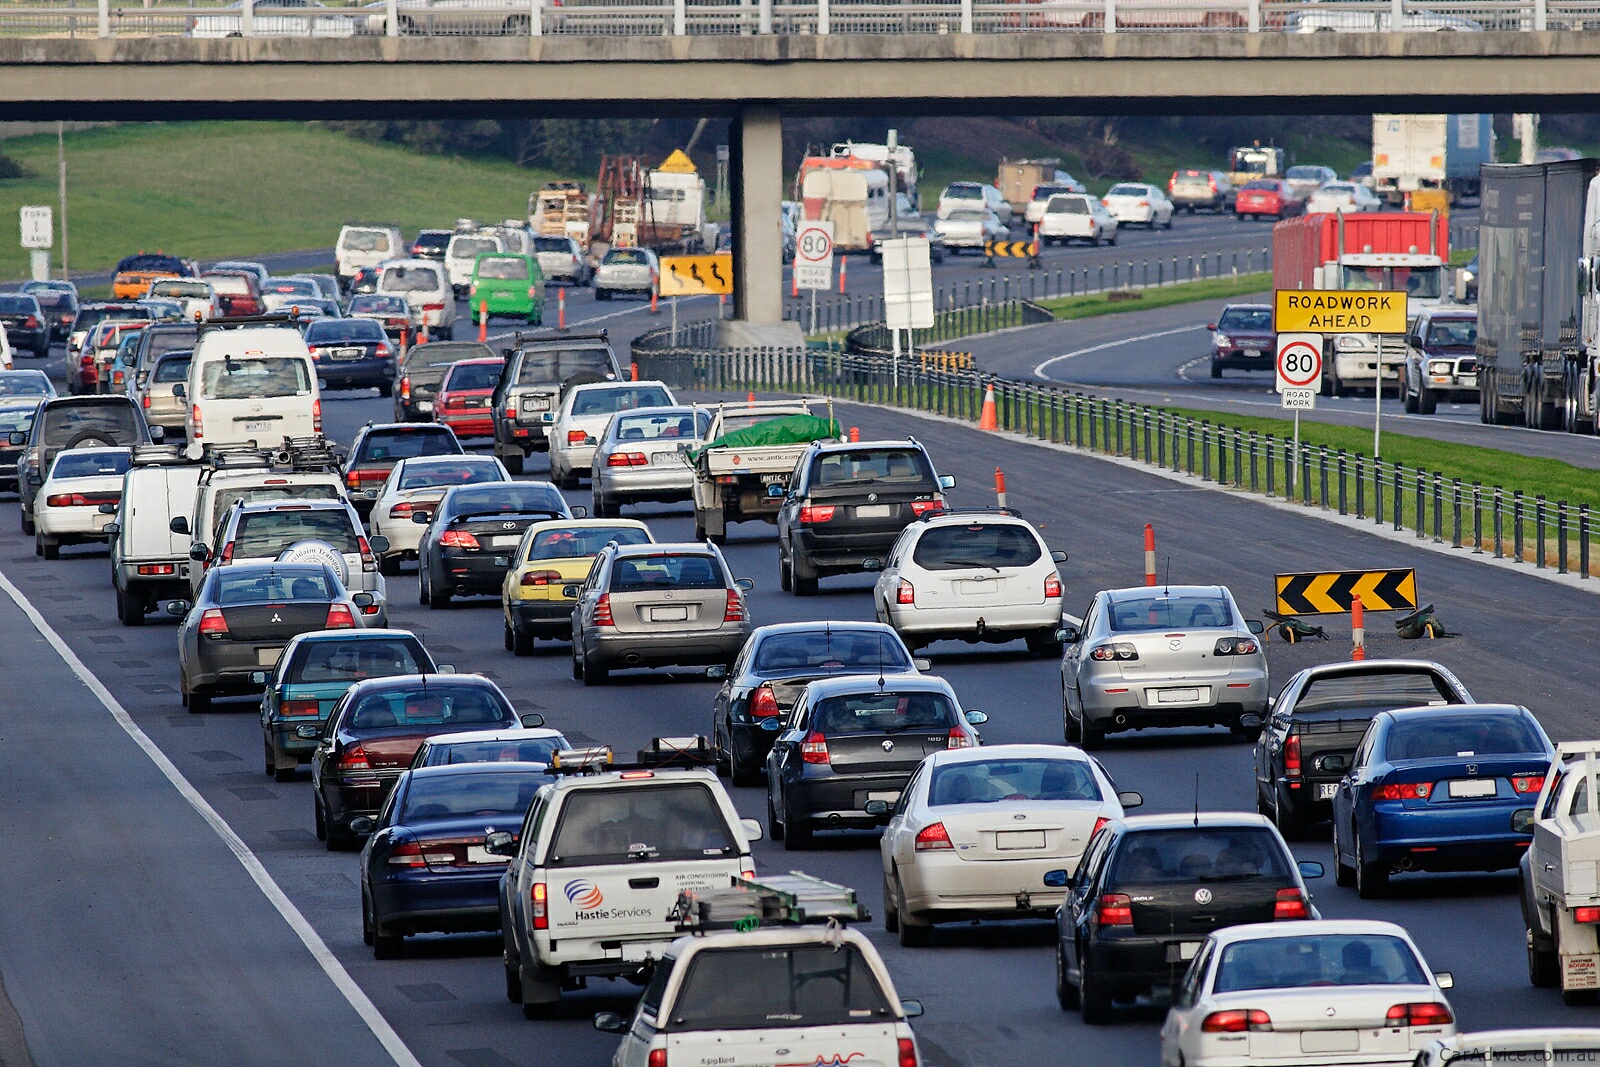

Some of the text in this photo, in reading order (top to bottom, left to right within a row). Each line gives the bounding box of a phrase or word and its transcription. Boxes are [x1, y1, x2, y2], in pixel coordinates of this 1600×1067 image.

[803, 236, 827, 253] 80
[1288, 296, 1391, 309] ROADWORK
[1309, 315, 1371, 327] AHEAD
[1286, 354, 1312, 372] 80
[374, 449, 381, 457] P
[319, 547, 341, 577] Transpor
[575, 907, 652, 920] Hastie Services
[701, 1057, 735, 1065] Applied
